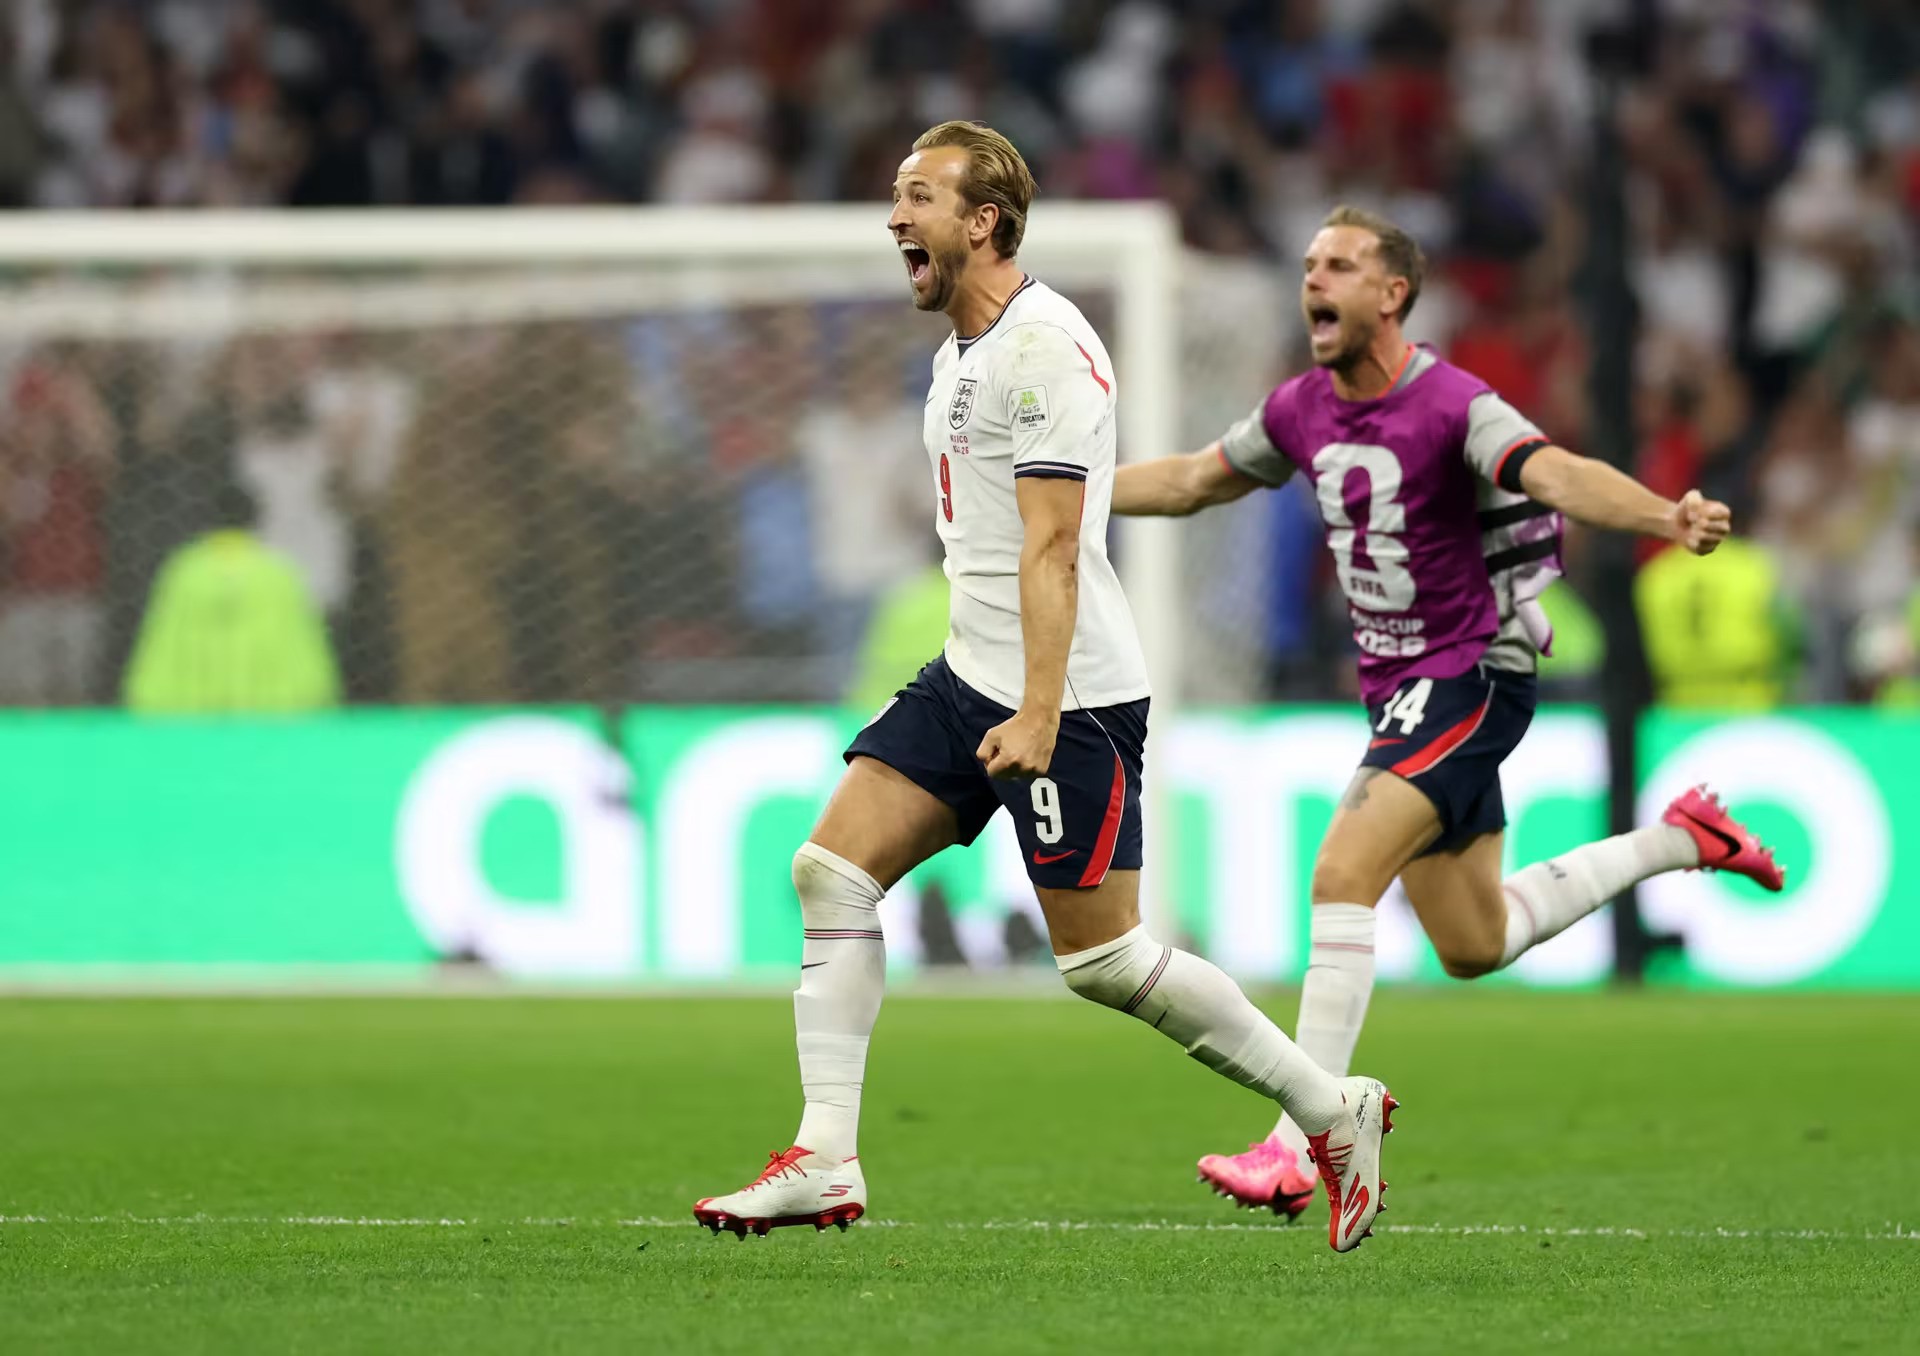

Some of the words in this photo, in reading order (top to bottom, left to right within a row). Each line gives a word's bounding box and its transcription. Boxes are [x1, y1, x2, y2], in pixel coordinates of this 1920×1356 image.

[1019, 413, 1046, 424] EDUCATION
[939, 452, 954, 523] 9
[1350, 576, 1388, 598] FIFA
[1353, 629, 1427, 657] 026
[1387, 618, 1425, 635] CUP
[1375, 677, 1435, 736] 14
[1030, 777, 1064, 845] 9
[394, 713, 1892, 986] armco
